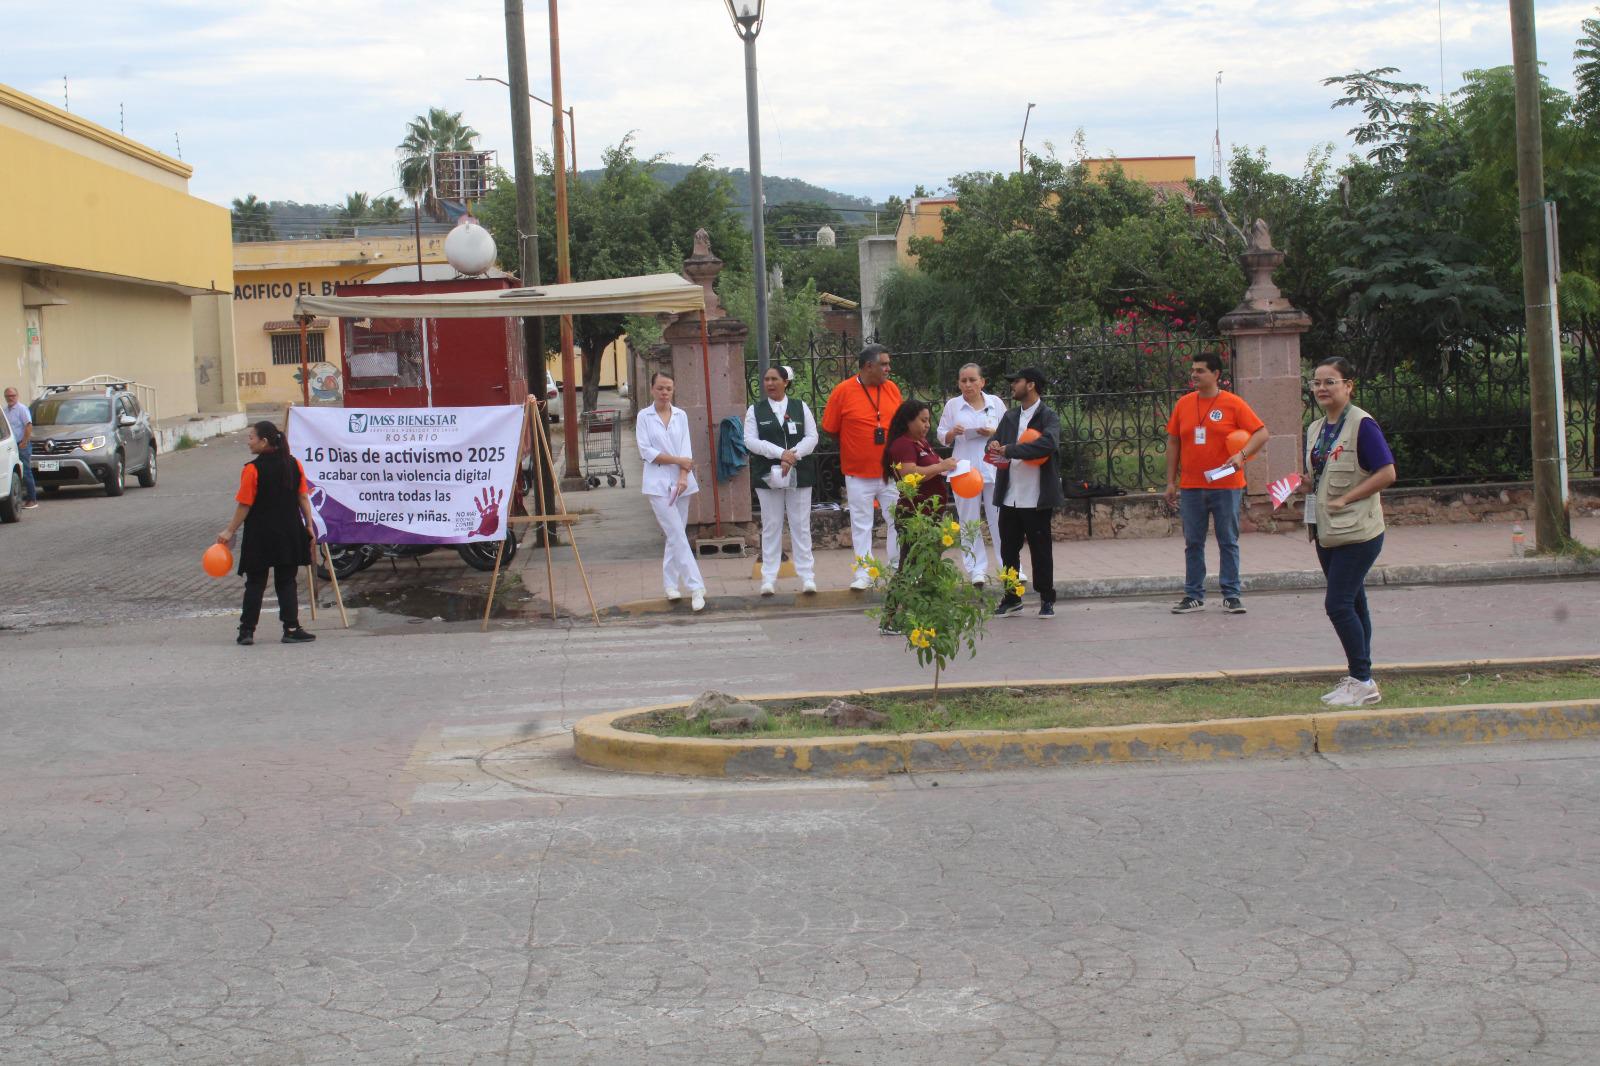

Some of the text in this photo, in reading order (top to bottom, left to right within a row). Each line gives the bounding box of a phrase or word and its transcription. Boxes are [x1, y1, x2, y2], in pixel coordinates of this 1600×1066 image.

[299, 282, 315, 296] EL
[369, 415, 457, 426] IMSS BIENESTAR
[385, 434, 438, 442] ROSARIO
[305, 448, 324, 462] 16
[362, 448, 380, 463] de
[385, 448, 463, 463] activismo
[468, 447, 505, 462] 2025
[319, 469, 491, 484] acabar con la violencia digital
[359, 490, 451, 501] contra todas las
[356, 511, 404, 524] mujeres
[408, 514, 414, 524] y
[417, 510, 451, 522] niñas.
